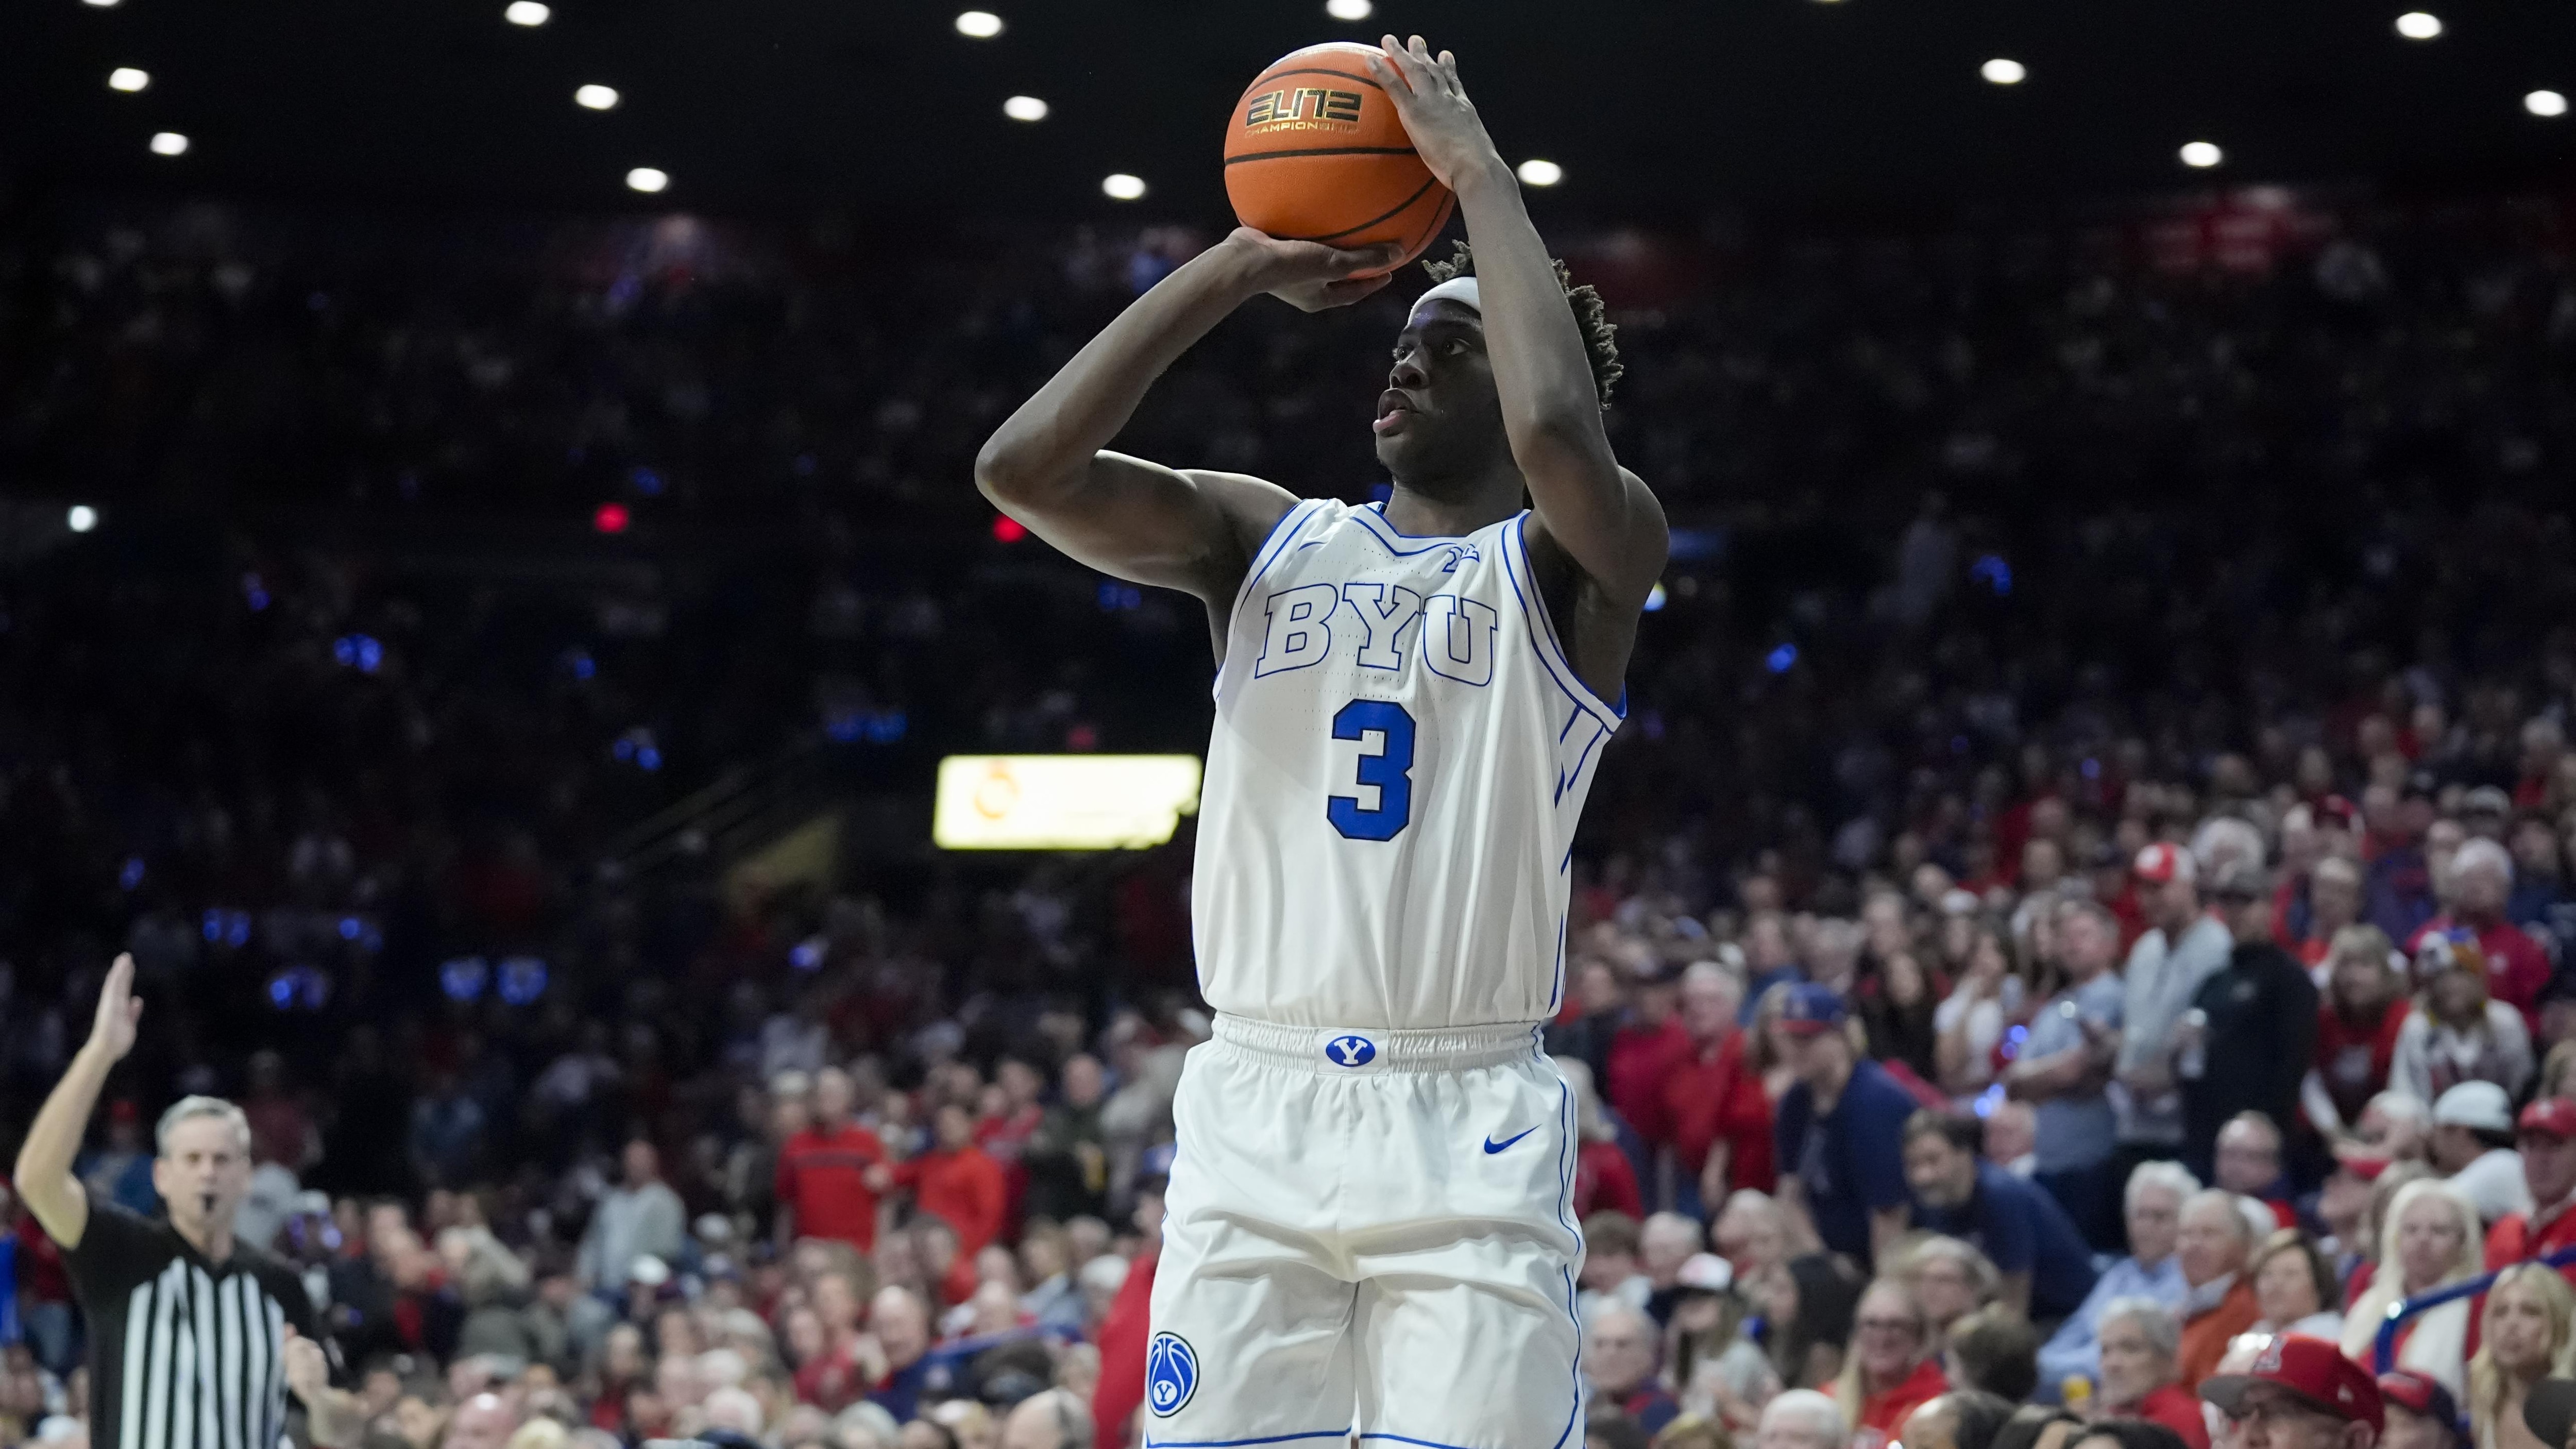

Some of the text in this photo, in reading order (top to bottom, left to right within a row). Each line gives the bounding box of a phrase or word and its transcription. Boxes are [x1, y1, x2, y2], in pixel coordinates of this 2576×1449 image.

[1246, 88, 1363, 127] ELITE
[1255, 583, 1498, 686] BYU
[1327, 699, 1416, 841] 3
[1333, 1038, 1368, 1065] Y
[1157, 1384, 1172, 1402] Y
